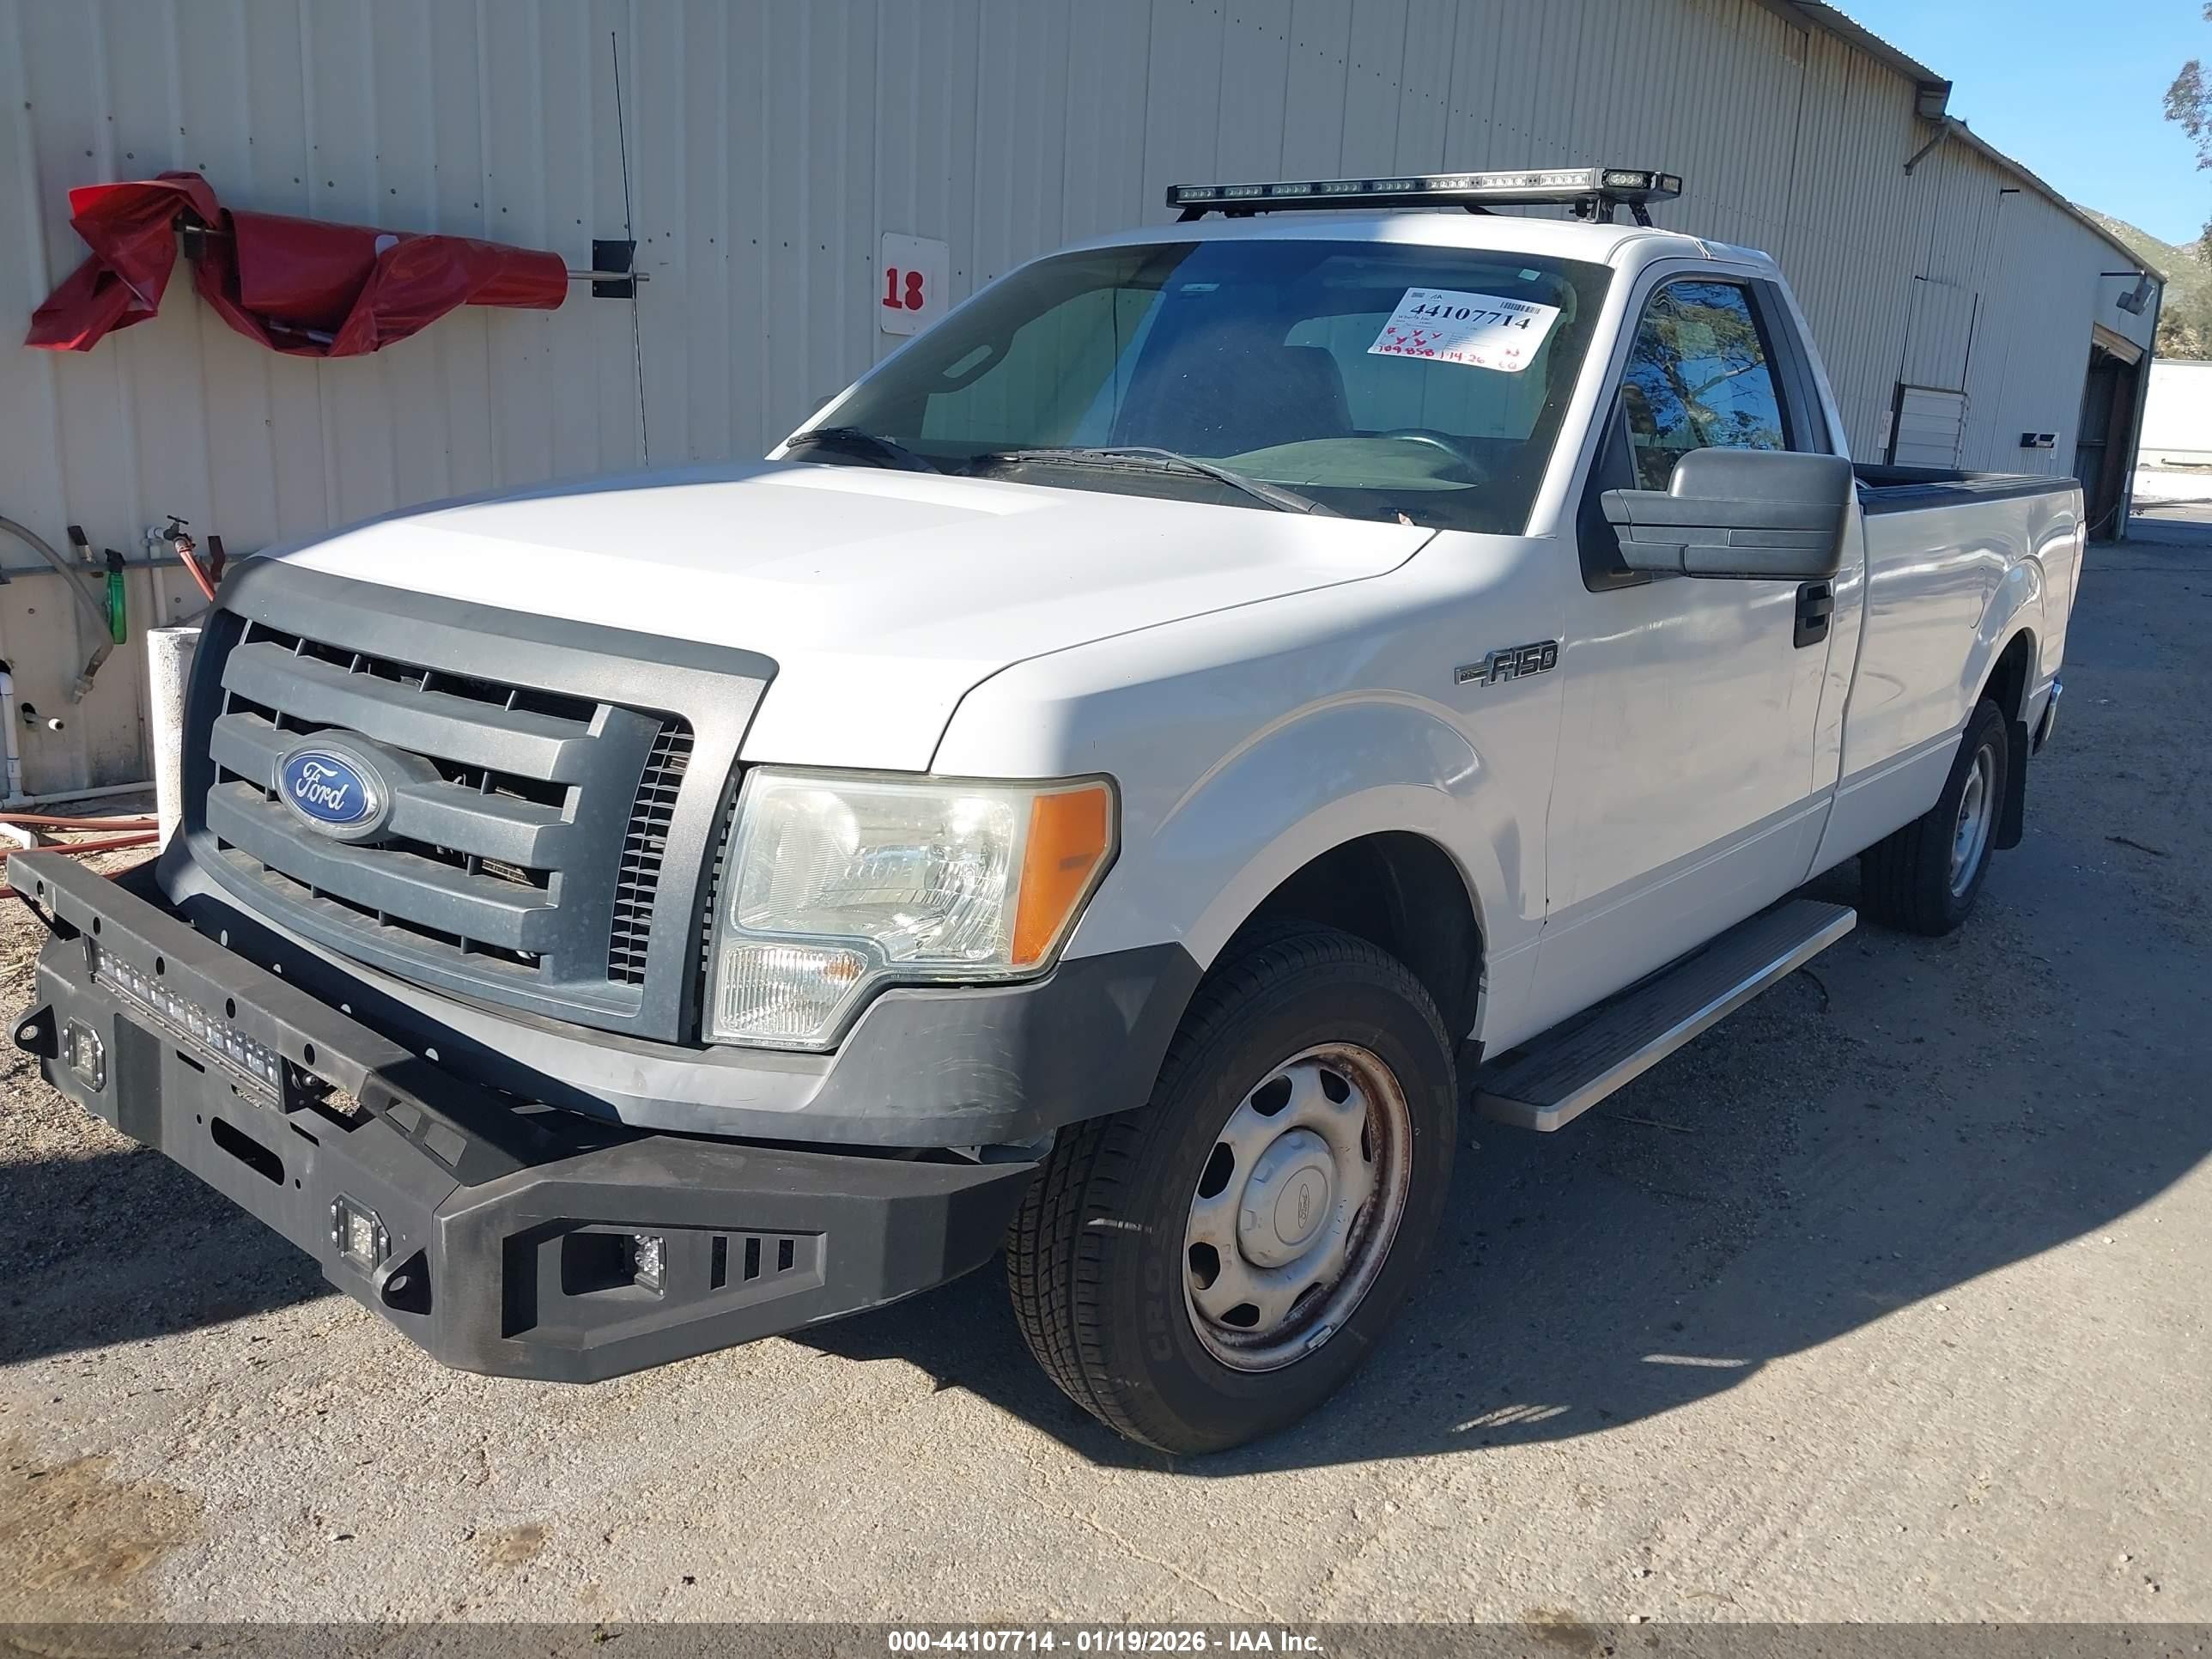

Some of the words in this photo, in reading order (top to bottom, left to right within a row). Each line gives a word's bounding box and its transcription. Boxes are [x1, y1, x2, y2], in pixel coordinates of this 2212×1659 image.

[883, 268, 923, 310] 18
[1410, 303, 1532, 331] 44107714
[295, 761, 349, 811] Ford
